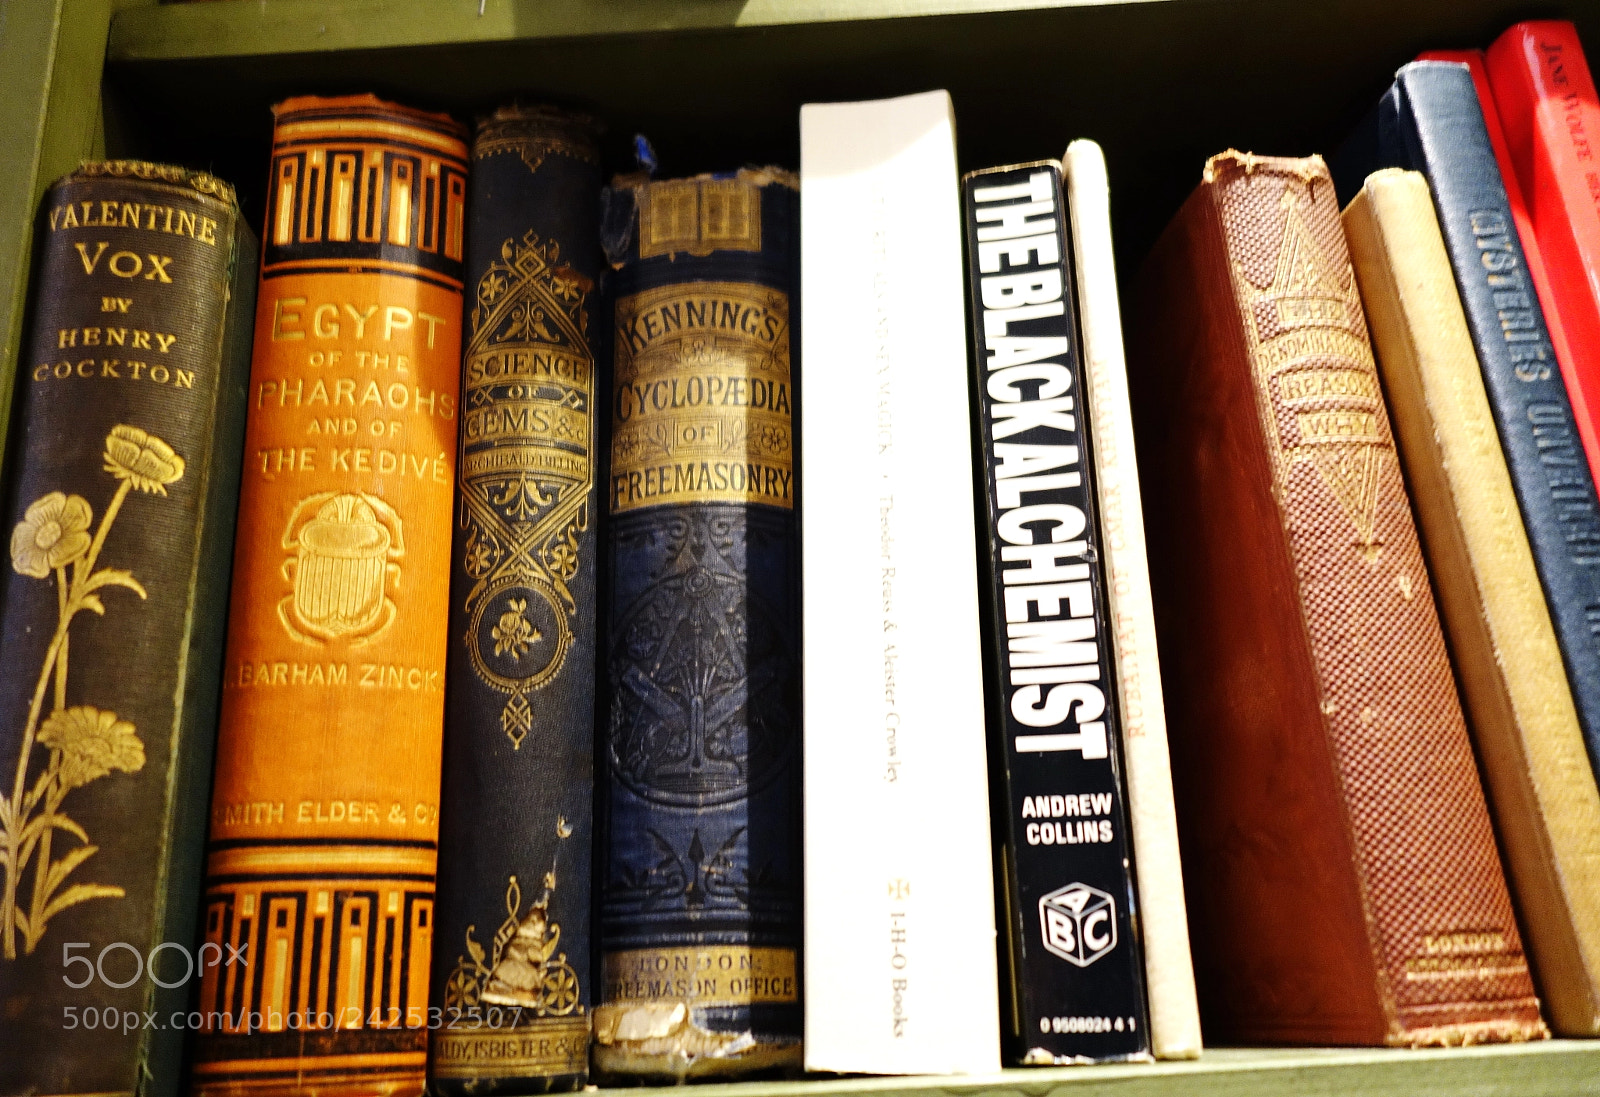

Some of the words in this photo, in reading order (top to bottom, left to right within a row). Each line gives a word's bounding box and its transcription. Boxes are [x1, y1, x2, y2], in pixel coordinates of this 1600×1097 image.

[50, 201, 218, 246] VALENTINE
[273, 297, 446, 350] EGYPT
[621, 300, 779, 356] KENNING'S
[58, 327, 176, 353] HENRY
[33, 359, 195, 388] COCKTON
[309, 350, 343, 367] OF
[355, 350, 409, 373] THE
[470, 353, 585, 382] SCIENCE
[258, 378, 454, 420] PHARAOHS
[306, 418, 358, 435] AND
[370, 419, 403, 438] OF
[466, 407, 549, 440] GEMS
[682, 425, 715, 443] OF
[258, 448, 316, 473] THE
[331, 448, 447, 484] KEDIVÉ
[612, 462, 791, 511] FREEMASONRY
[993, 442, 1109, 760] ALCHEMIST
[239, 663, 347, 686] BARHAM
[297, 801, 380, 824] ELDER
[388, 802, 406, 824] &
[1021, 792, 1113, 819] ANDREW
[1026, 819, 1114, 846] COLLINS
[730, 976, 793, 997] OFFICE
[892, 978, 909, 1038] Books
